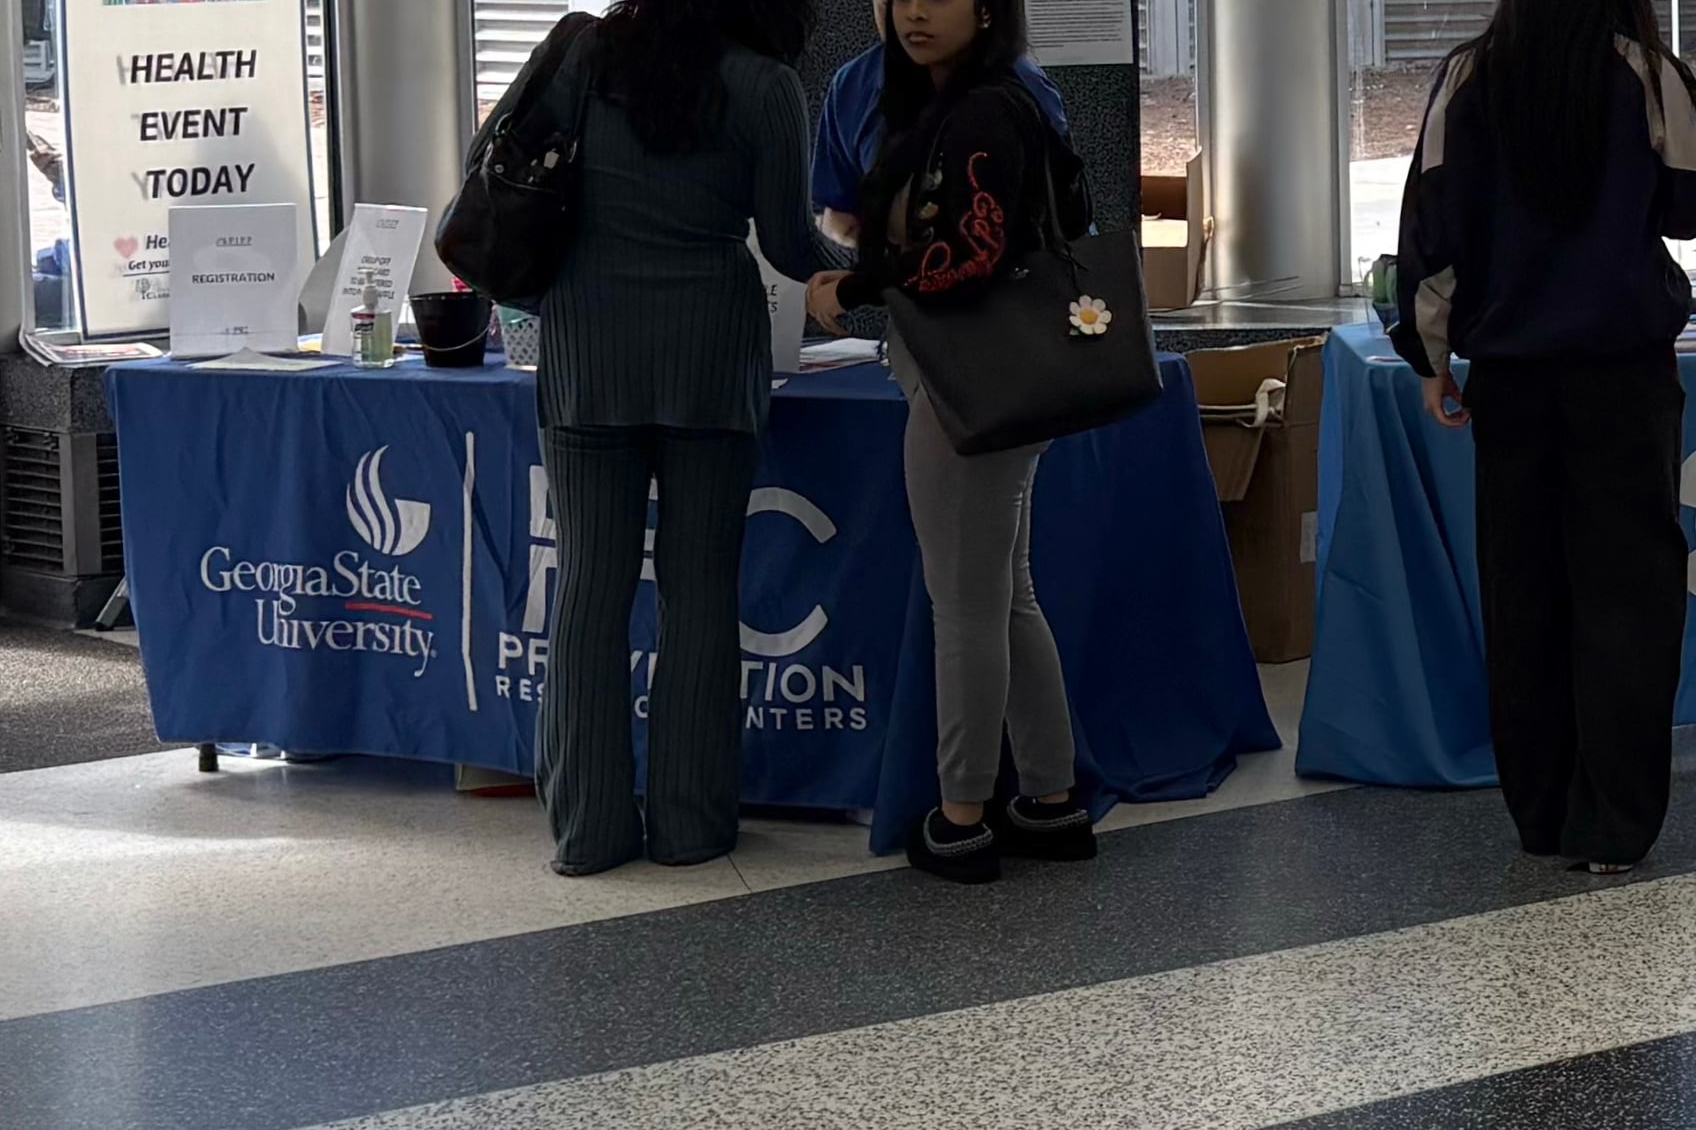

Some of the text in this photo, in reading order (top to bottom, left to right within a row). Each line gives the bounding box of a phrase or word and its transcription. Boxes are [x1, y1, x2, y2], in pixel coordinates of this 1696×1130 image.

[130, 50, 257, 83] HEALTH
[140, 107, 248, 141] EVENT
[147, 163, 255, 199] TODAY
[145, 235, 169, 251] He
[128, 259, 169, 273] Get you
[192, 272, 275, 284] REGISTRATION
[200, 546, 421, 616] Georgia State
[256, 599, 435, 678] University
